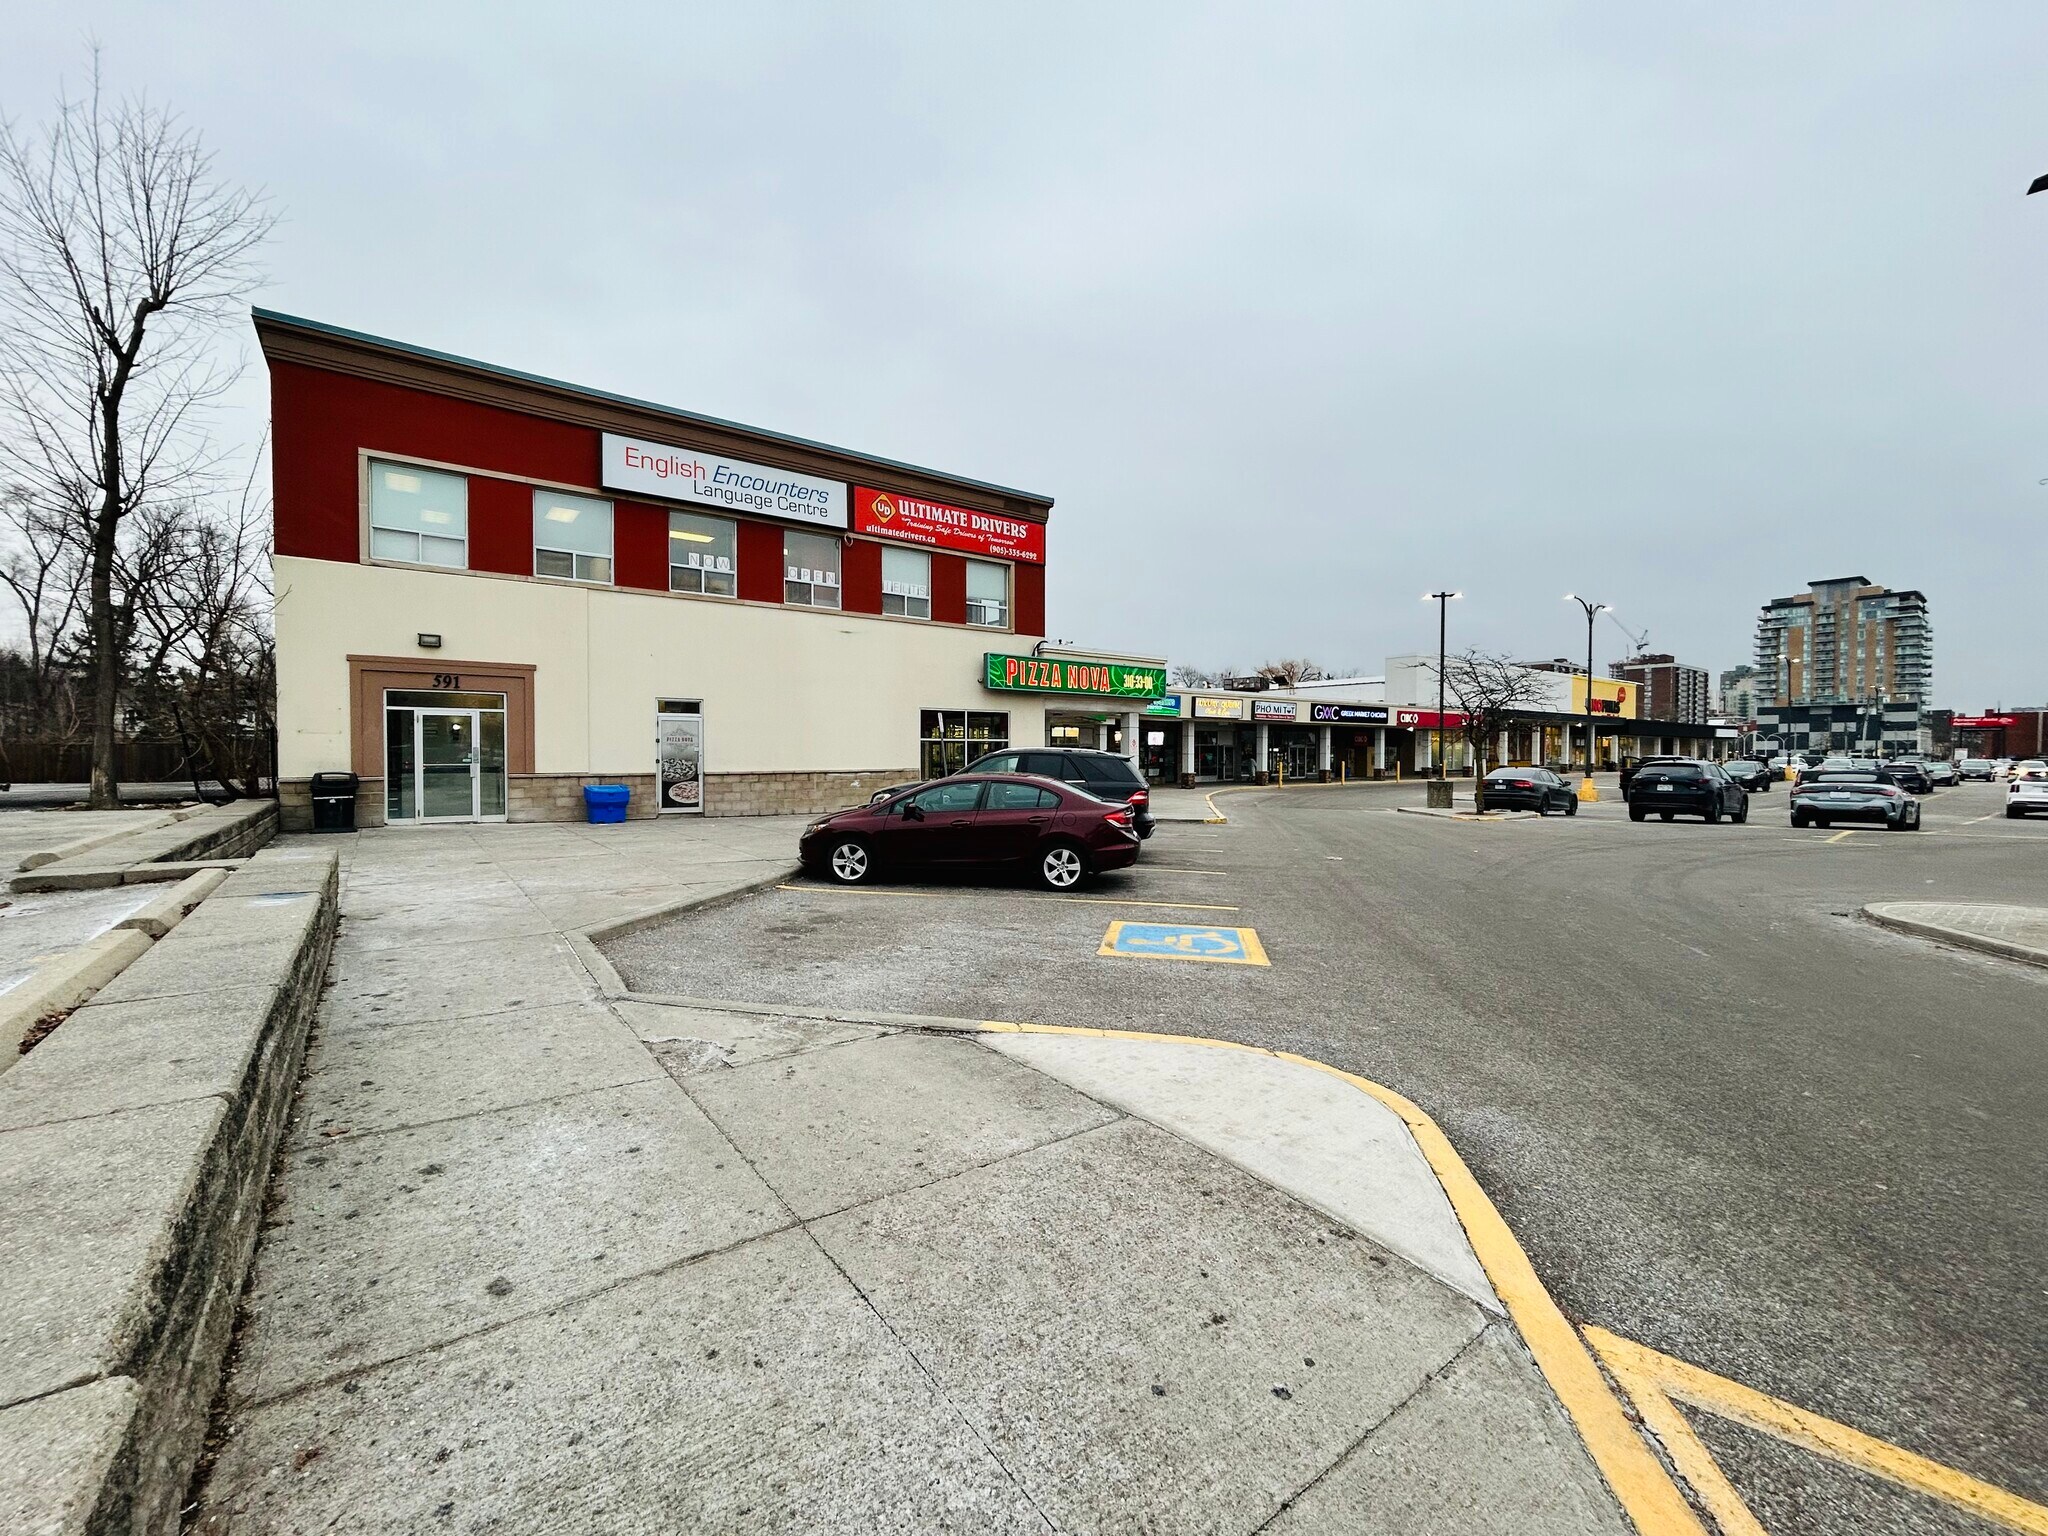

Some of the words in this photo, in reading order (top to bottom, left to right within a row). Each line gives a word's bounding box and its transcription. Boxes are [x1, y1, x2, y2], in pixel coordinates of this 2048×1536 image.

[625, 446, 706, 480] English
[712, 464, 829, 504] Encounters
[694, 479, 773, 509] Language
[777, 496, 828, 518] Centre
[898, 500, 968, 528] ULTIMATE
[866, 524, 936, 544] ultimatedrivers.ca
[935, 524, 952, 536] Safe
[953, 527, 977, 539] Drivers
[978, 533, 985, 543] of
[689, 554, 730, 570] NOW
[788, 567, 835, 583] OPEN
[885, 582, 927, 596] IELTS
[432, 674, 460, 689] 591
[1006, 658, 1062, 688] PIZZA
[1067, 665, 1111, 692] NOVA
[1255, 704, 1271, 713] PHO
[1273, 705, 1282, 714] MI
[1400, 713, 1413, 723] CIBC
